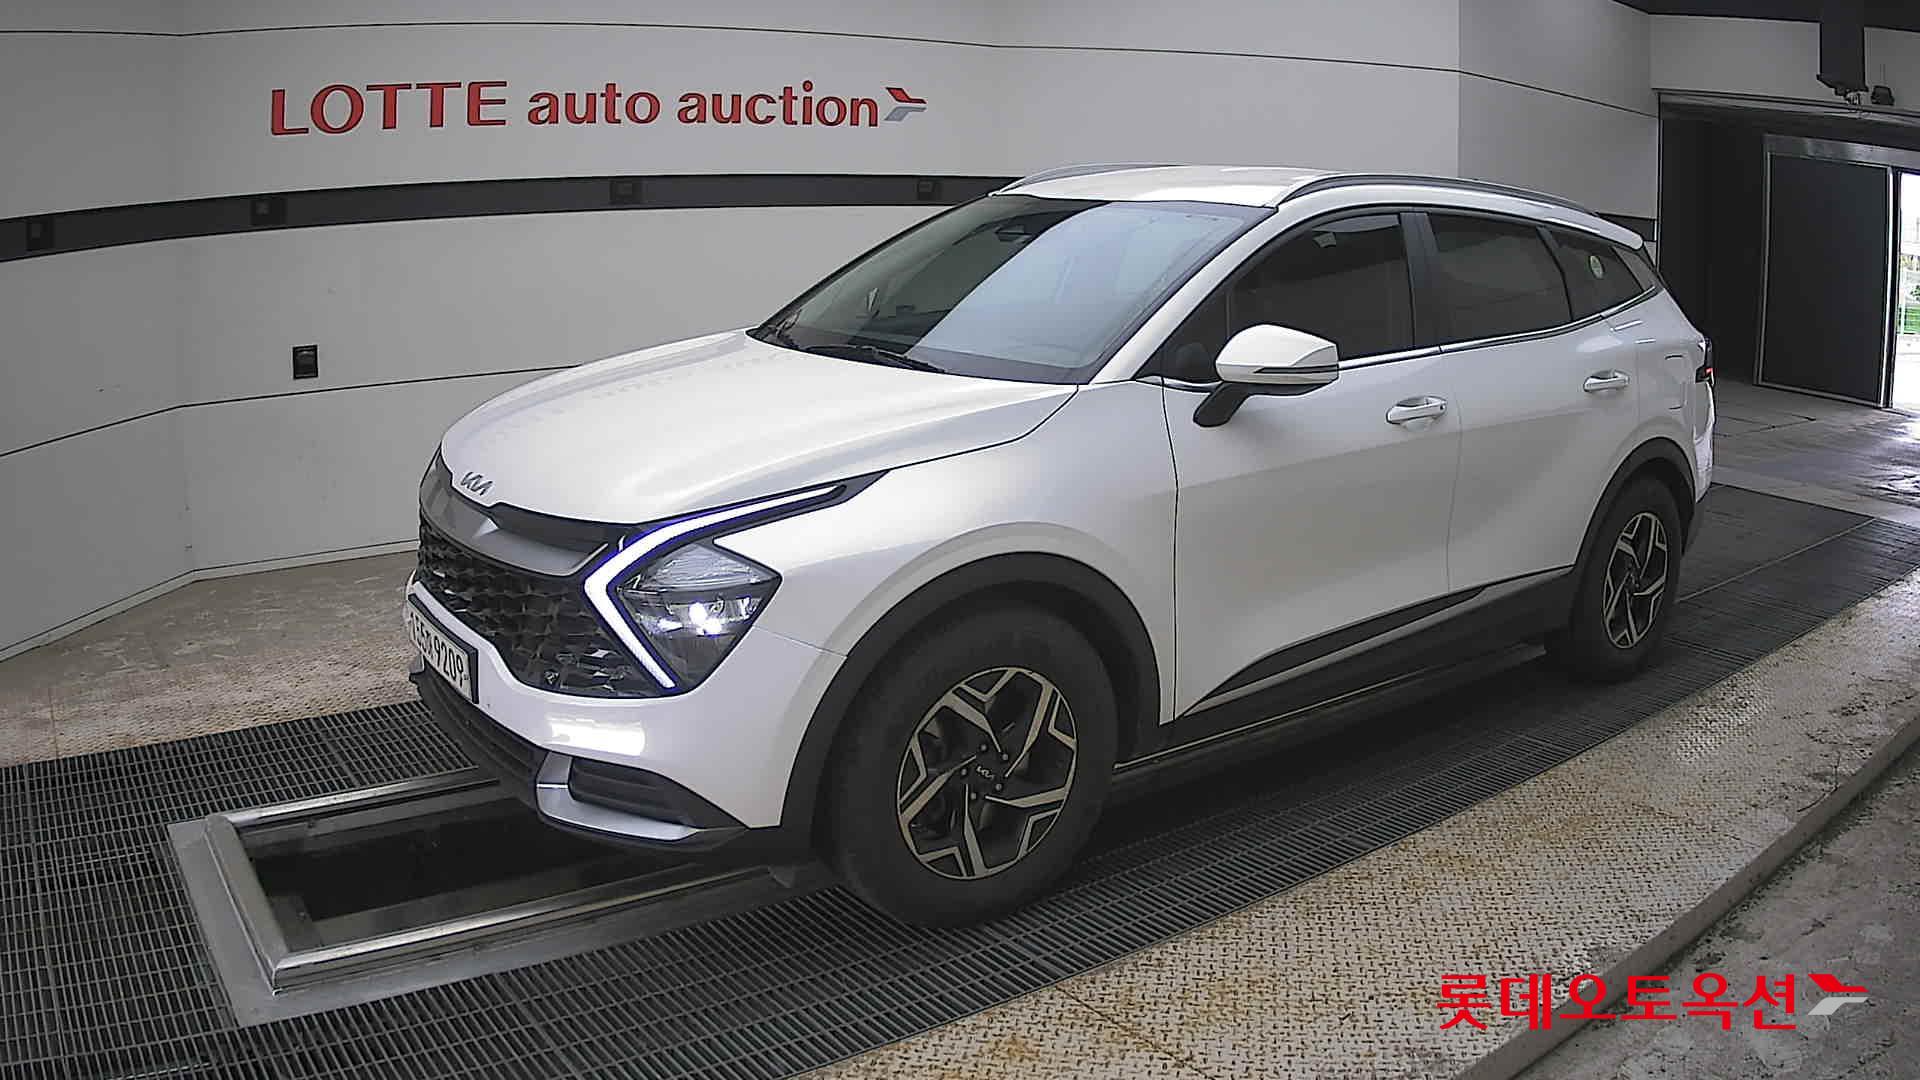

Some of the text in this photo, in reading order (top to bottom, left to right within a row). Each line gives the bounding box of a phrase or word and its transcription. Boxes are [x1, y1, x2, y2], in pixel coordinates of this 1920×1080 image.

[270, 80, 879, 136] LOTTE auto auction
